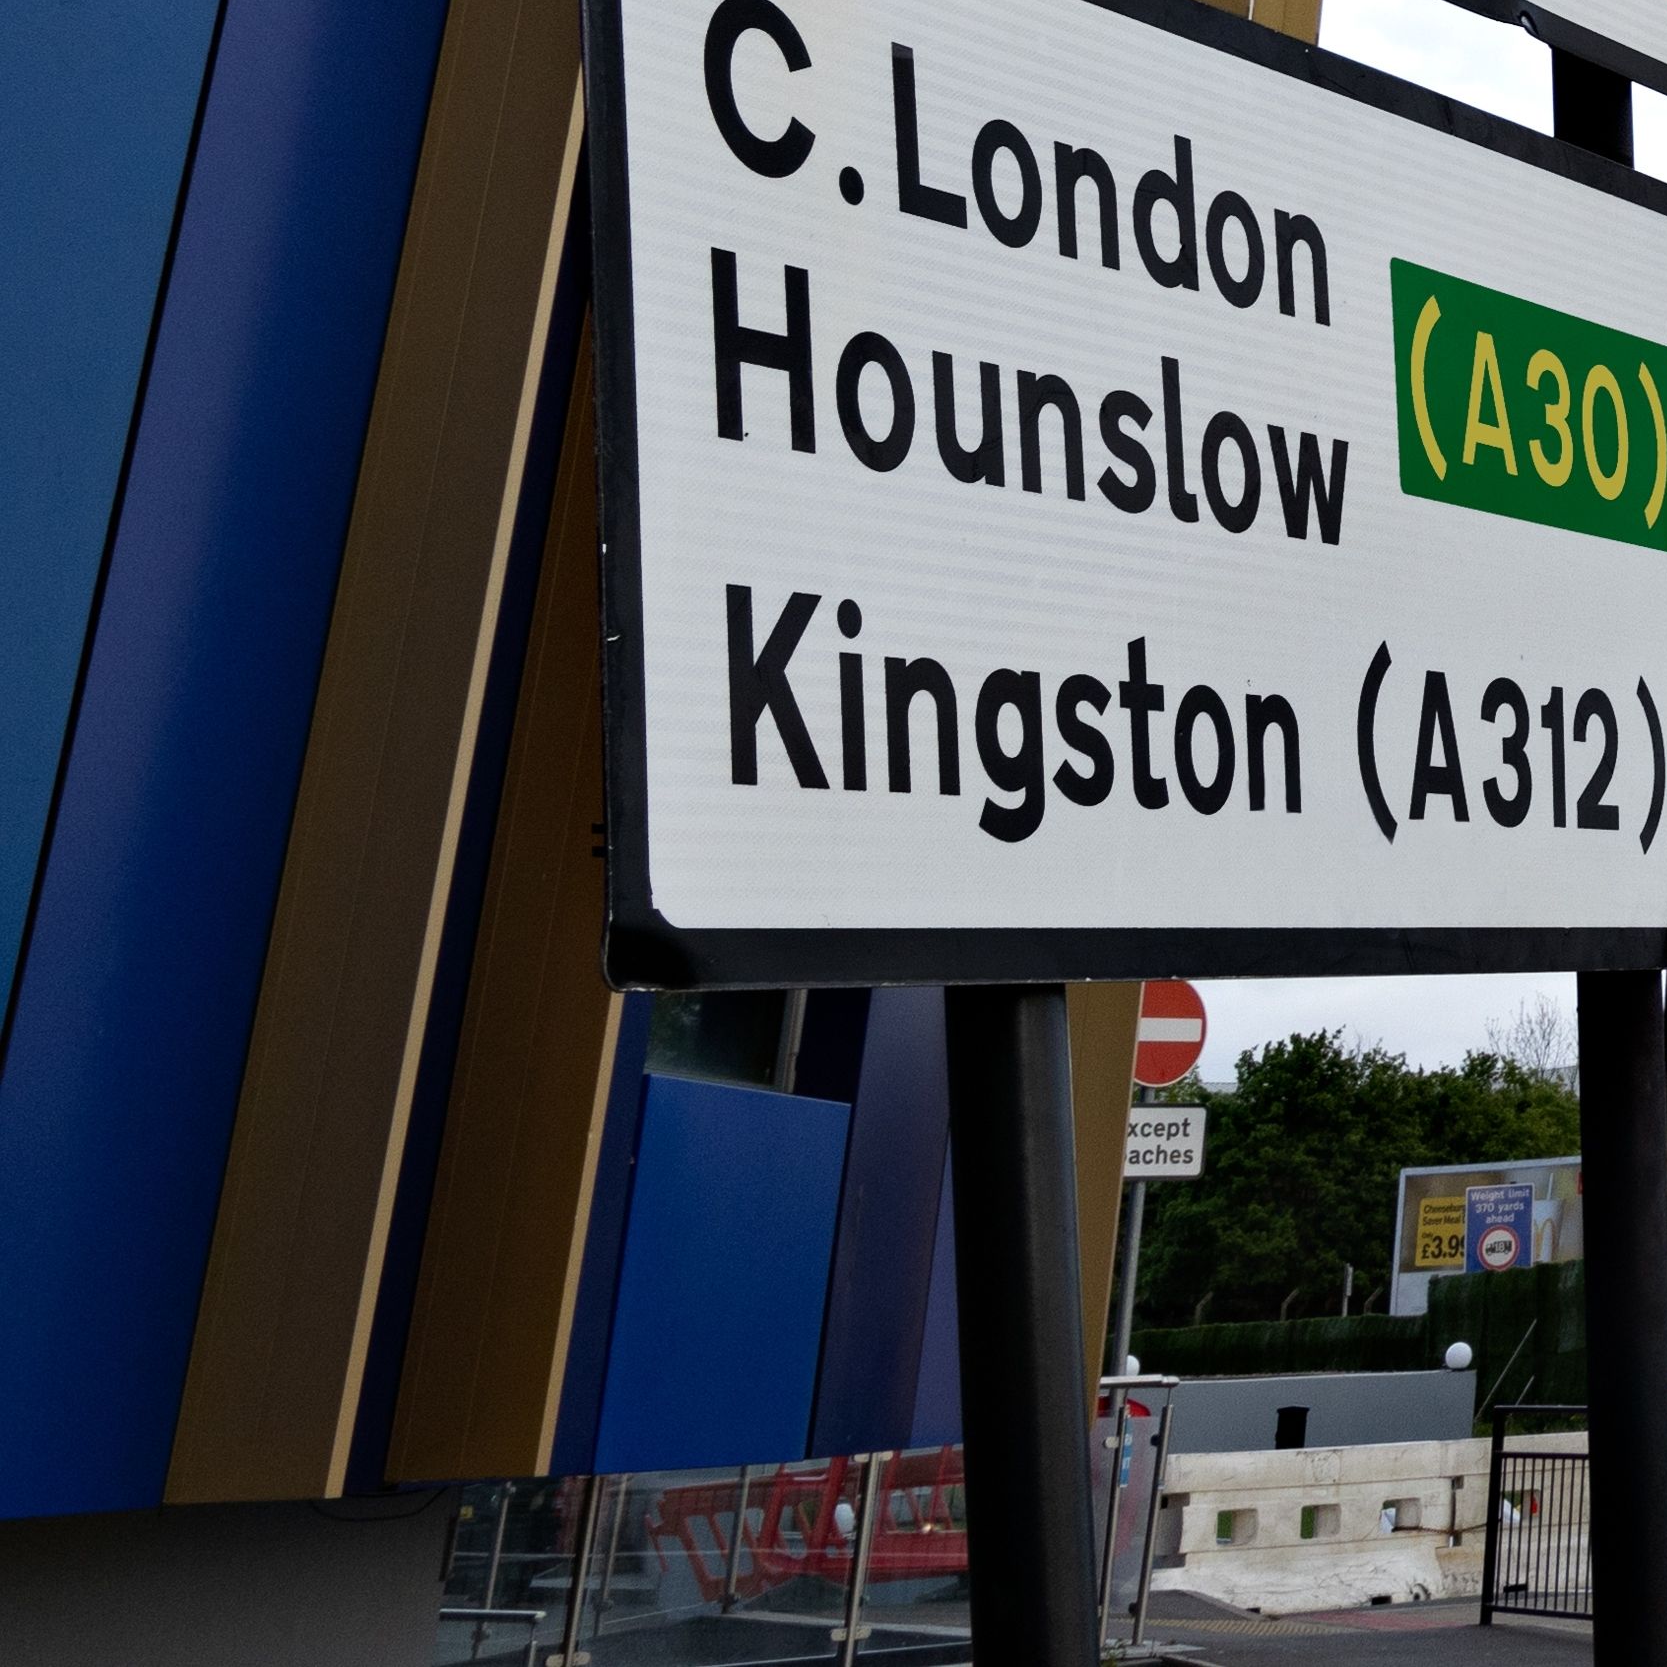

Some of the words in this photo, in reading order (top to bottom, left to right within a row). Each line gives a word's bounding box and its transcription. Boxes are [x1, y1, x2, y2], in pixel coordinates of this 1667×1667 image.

[710, 247, 1350, 546] Hounslow
[1410, 294, 1667, 530] (A30)
[724, 583, 1303, 843] Kingston
[1357, 640, 1666, 856] (A312)
[1127, 1117, 1191, 1141] xcept
[1128, 1144, 1194, 1165] aches
[1471, 1190, 1504, 1202] Weight
[1509, 1188, 1530, 1198] limit
[1475, 1203, 1494, 1213] 370
[1498, 1202, 1524, 1213] yards
[1486, 1213, 1515, 1224] ahead
